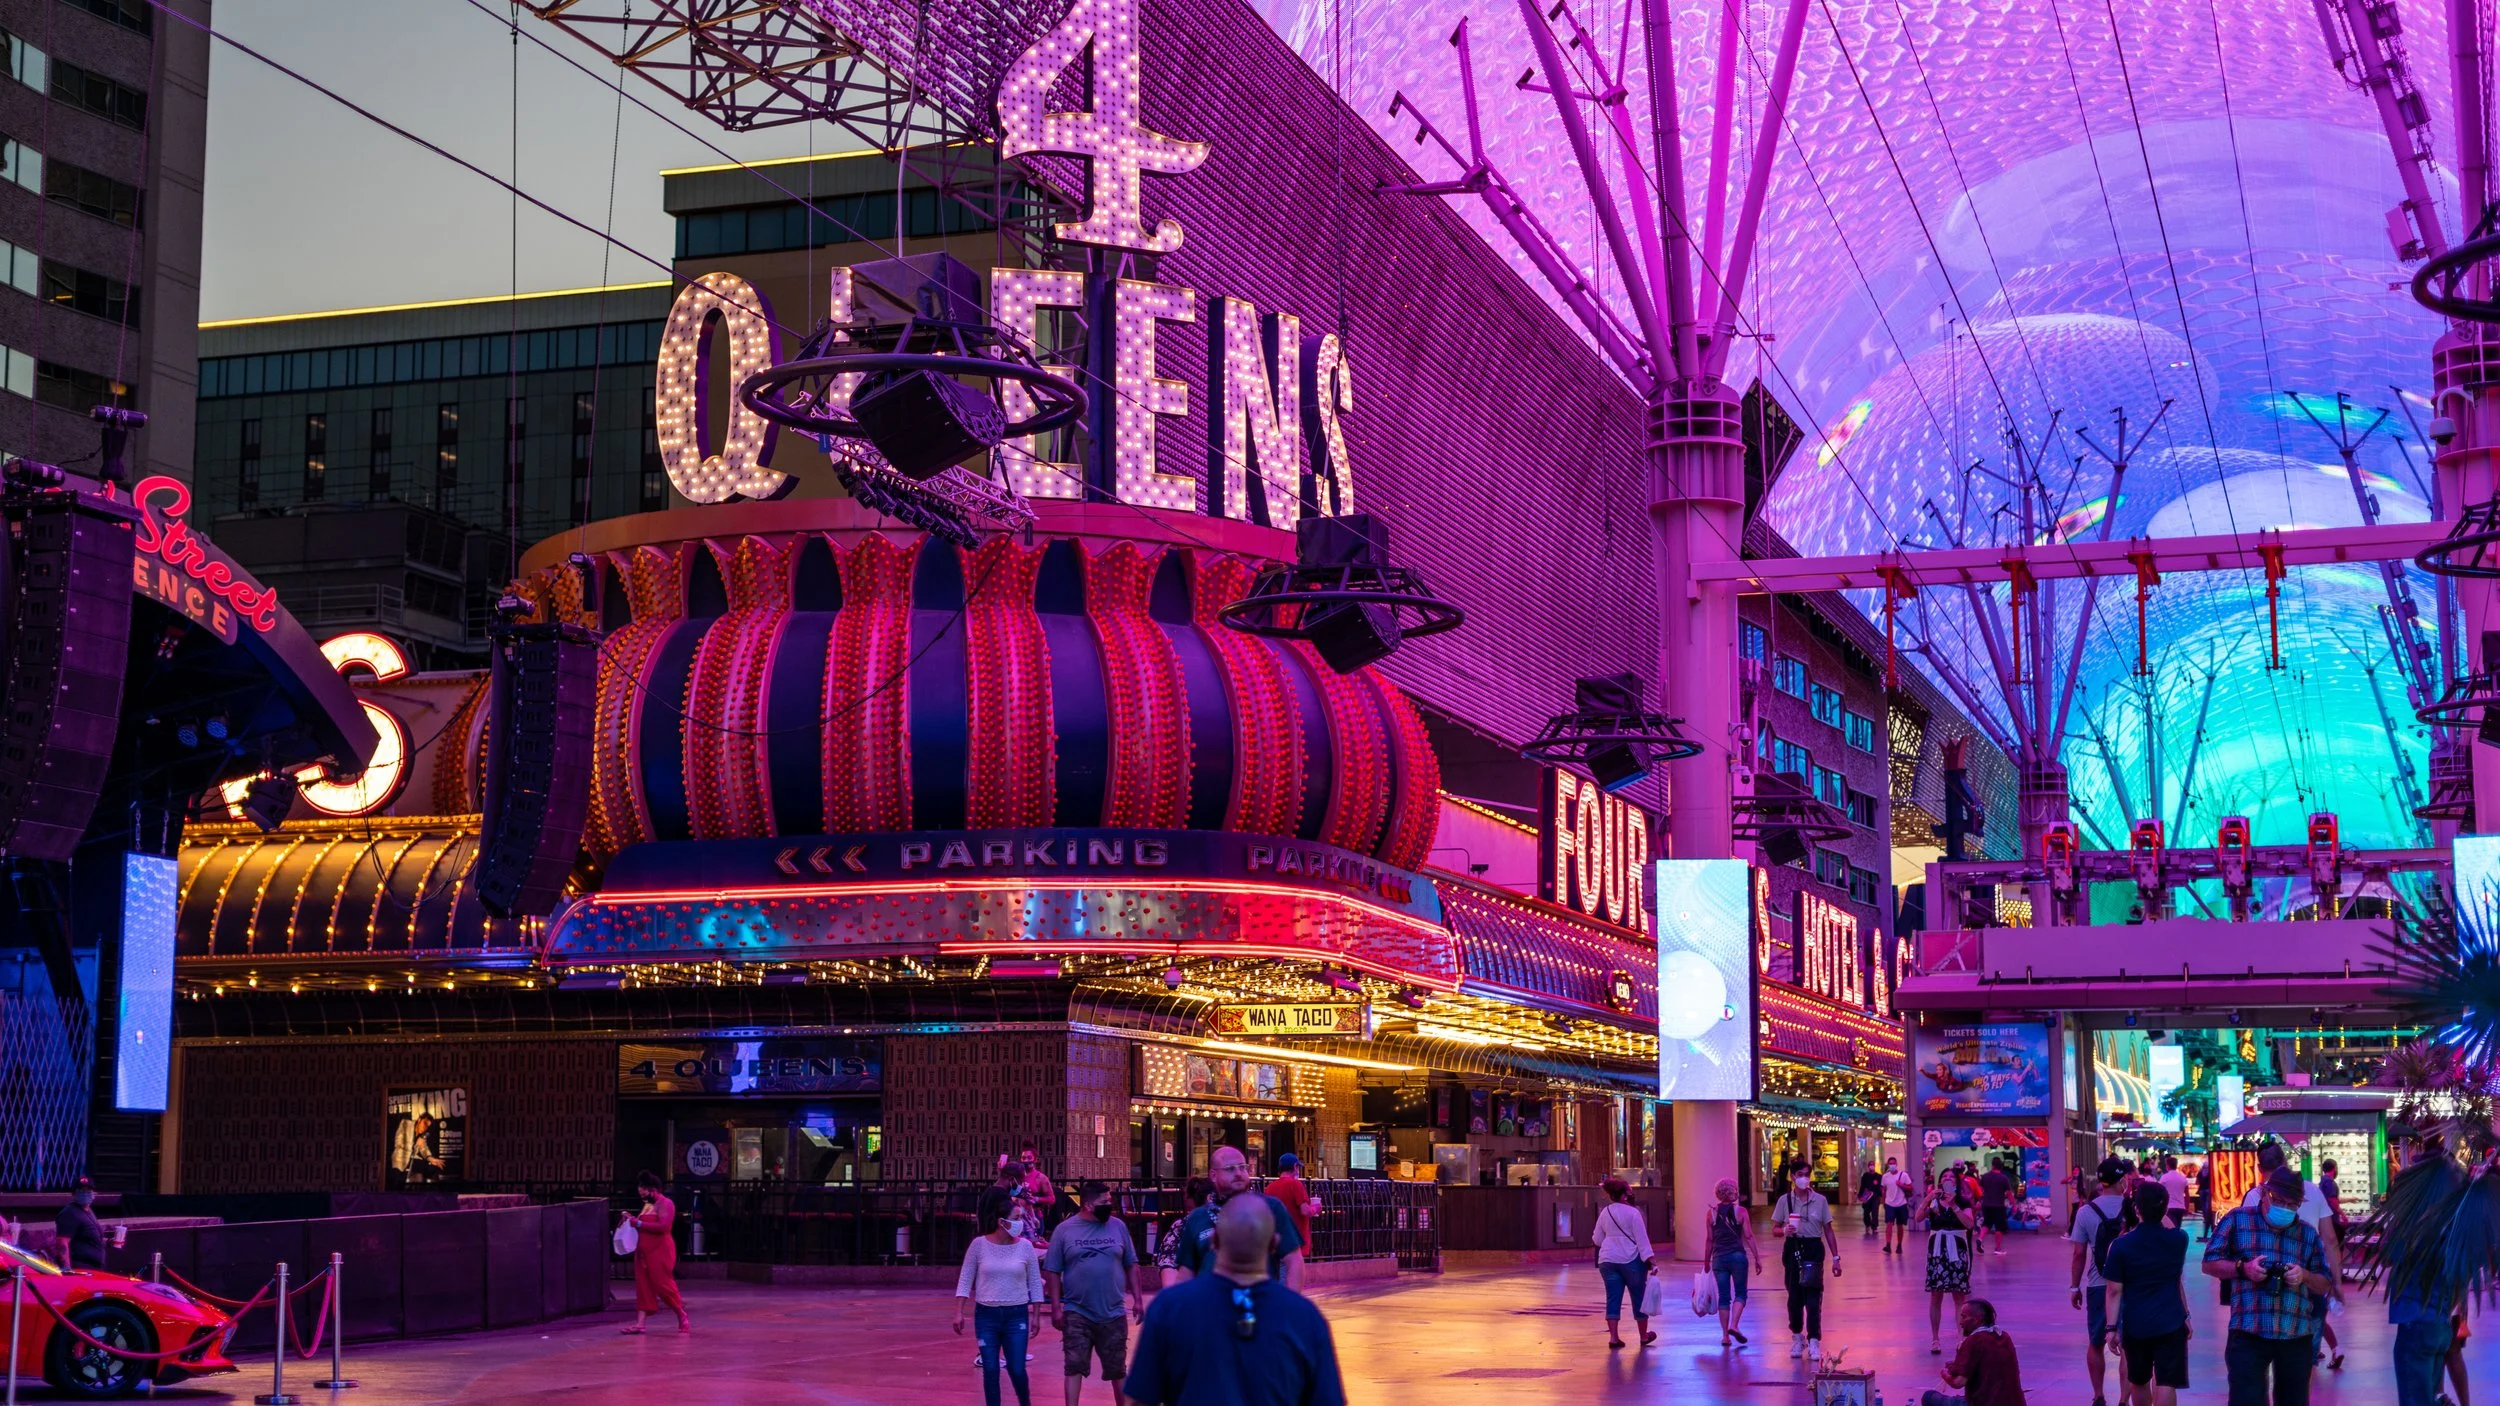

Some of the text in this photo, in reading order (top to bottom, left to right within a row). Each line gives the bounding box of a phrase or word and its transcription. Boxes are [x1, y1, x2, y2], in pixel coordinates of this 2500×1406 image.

[998, 0, 1211, 254] 4
[656, 268, 1354, 530] QEENS
[134, 476, 277, 632] Street
[901, 838, 1168, 869] PARKING
[1556, 768, 1649, 934] FOUR
[1248, 845, 1378, 892] PARKING
[1801, 890, 1866, 1010] HOTEL
[1873, 927, 1889, 1016] &
[1249, 1008, 1332, 1026] WANA TACO
[1944, 1028, 2019, 1037] TICKETS SOLD HERE
[630, 1057, 869, 1079] 4 QUEENS
[1991, 1073, 2011, 1082] WAYS
[1981, 1080, 2005, 1092] TO FLY
[388, 1105, 398, 1114] OF
[411, 1088, 467, 1120] KING
[2261, 1099, 2292, 1109] LASSES
[691, 1157, 712, 1168] TACO
[1074, 1238, 1116, 1247] Reebok
